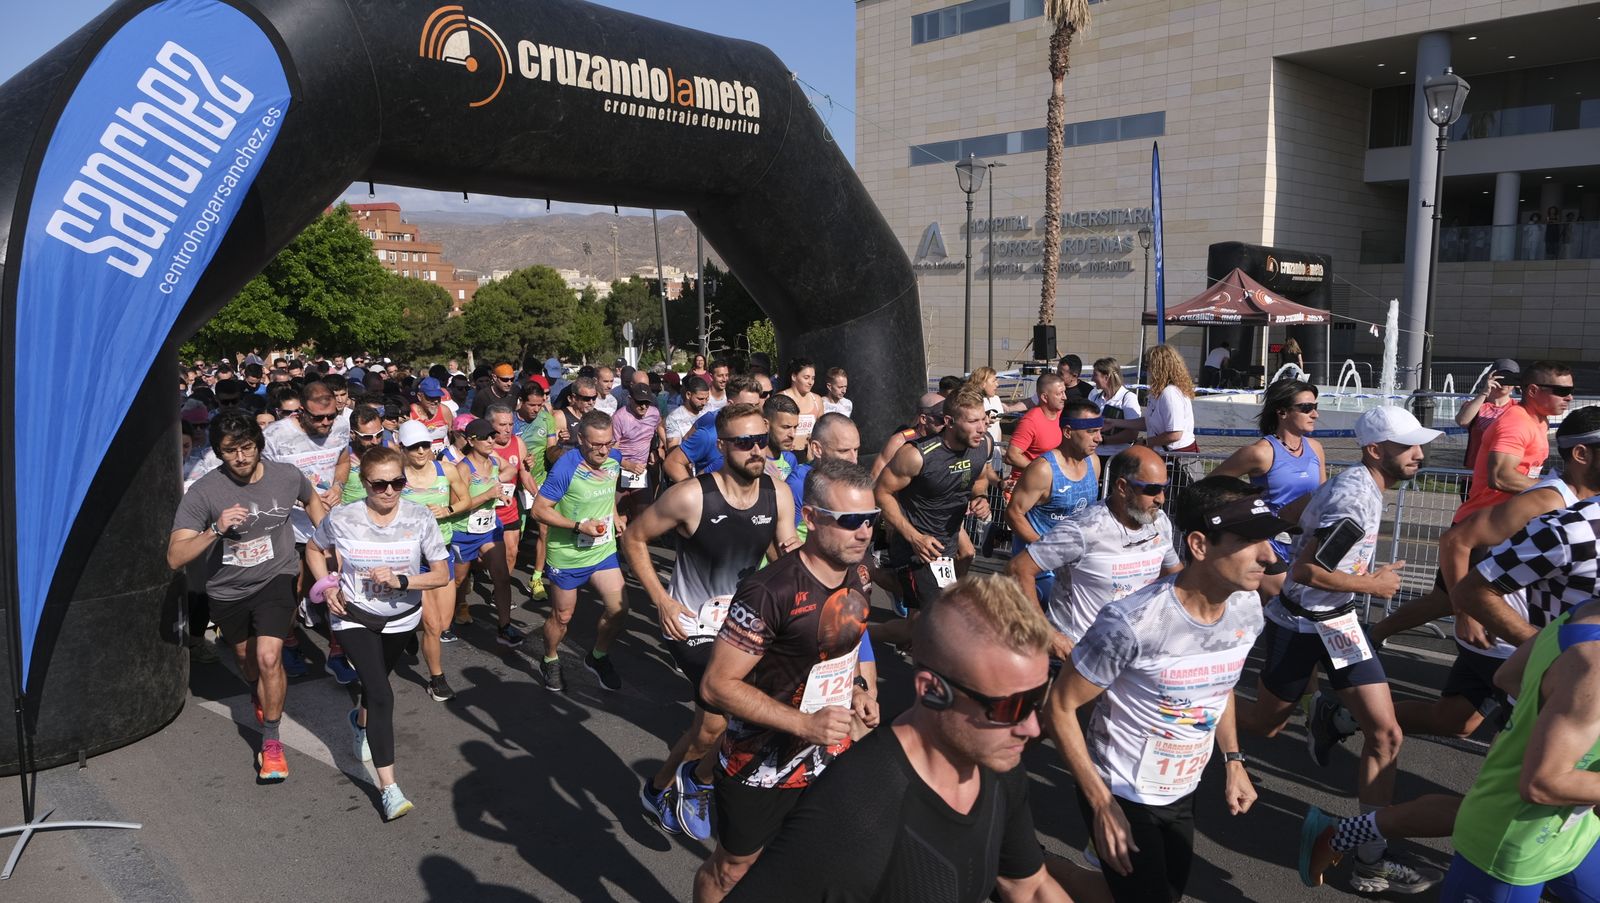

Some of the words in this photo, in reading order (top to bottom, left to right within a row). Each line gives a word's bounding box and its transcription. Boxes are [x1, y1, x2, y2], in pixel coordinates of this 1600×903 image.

[604, 98, 698, 126] cronometraje
[702, 113, 760, 135] deportivo
[159, 106, 281, 295] centrohogarsanchez.es
[1327, 629, 1361, 652] 1006
[1169, 665, 1210, 680] CARRERA
[1211, 663, 1226, 675] SIN
[1156, 751, 1208, 777] 1129
